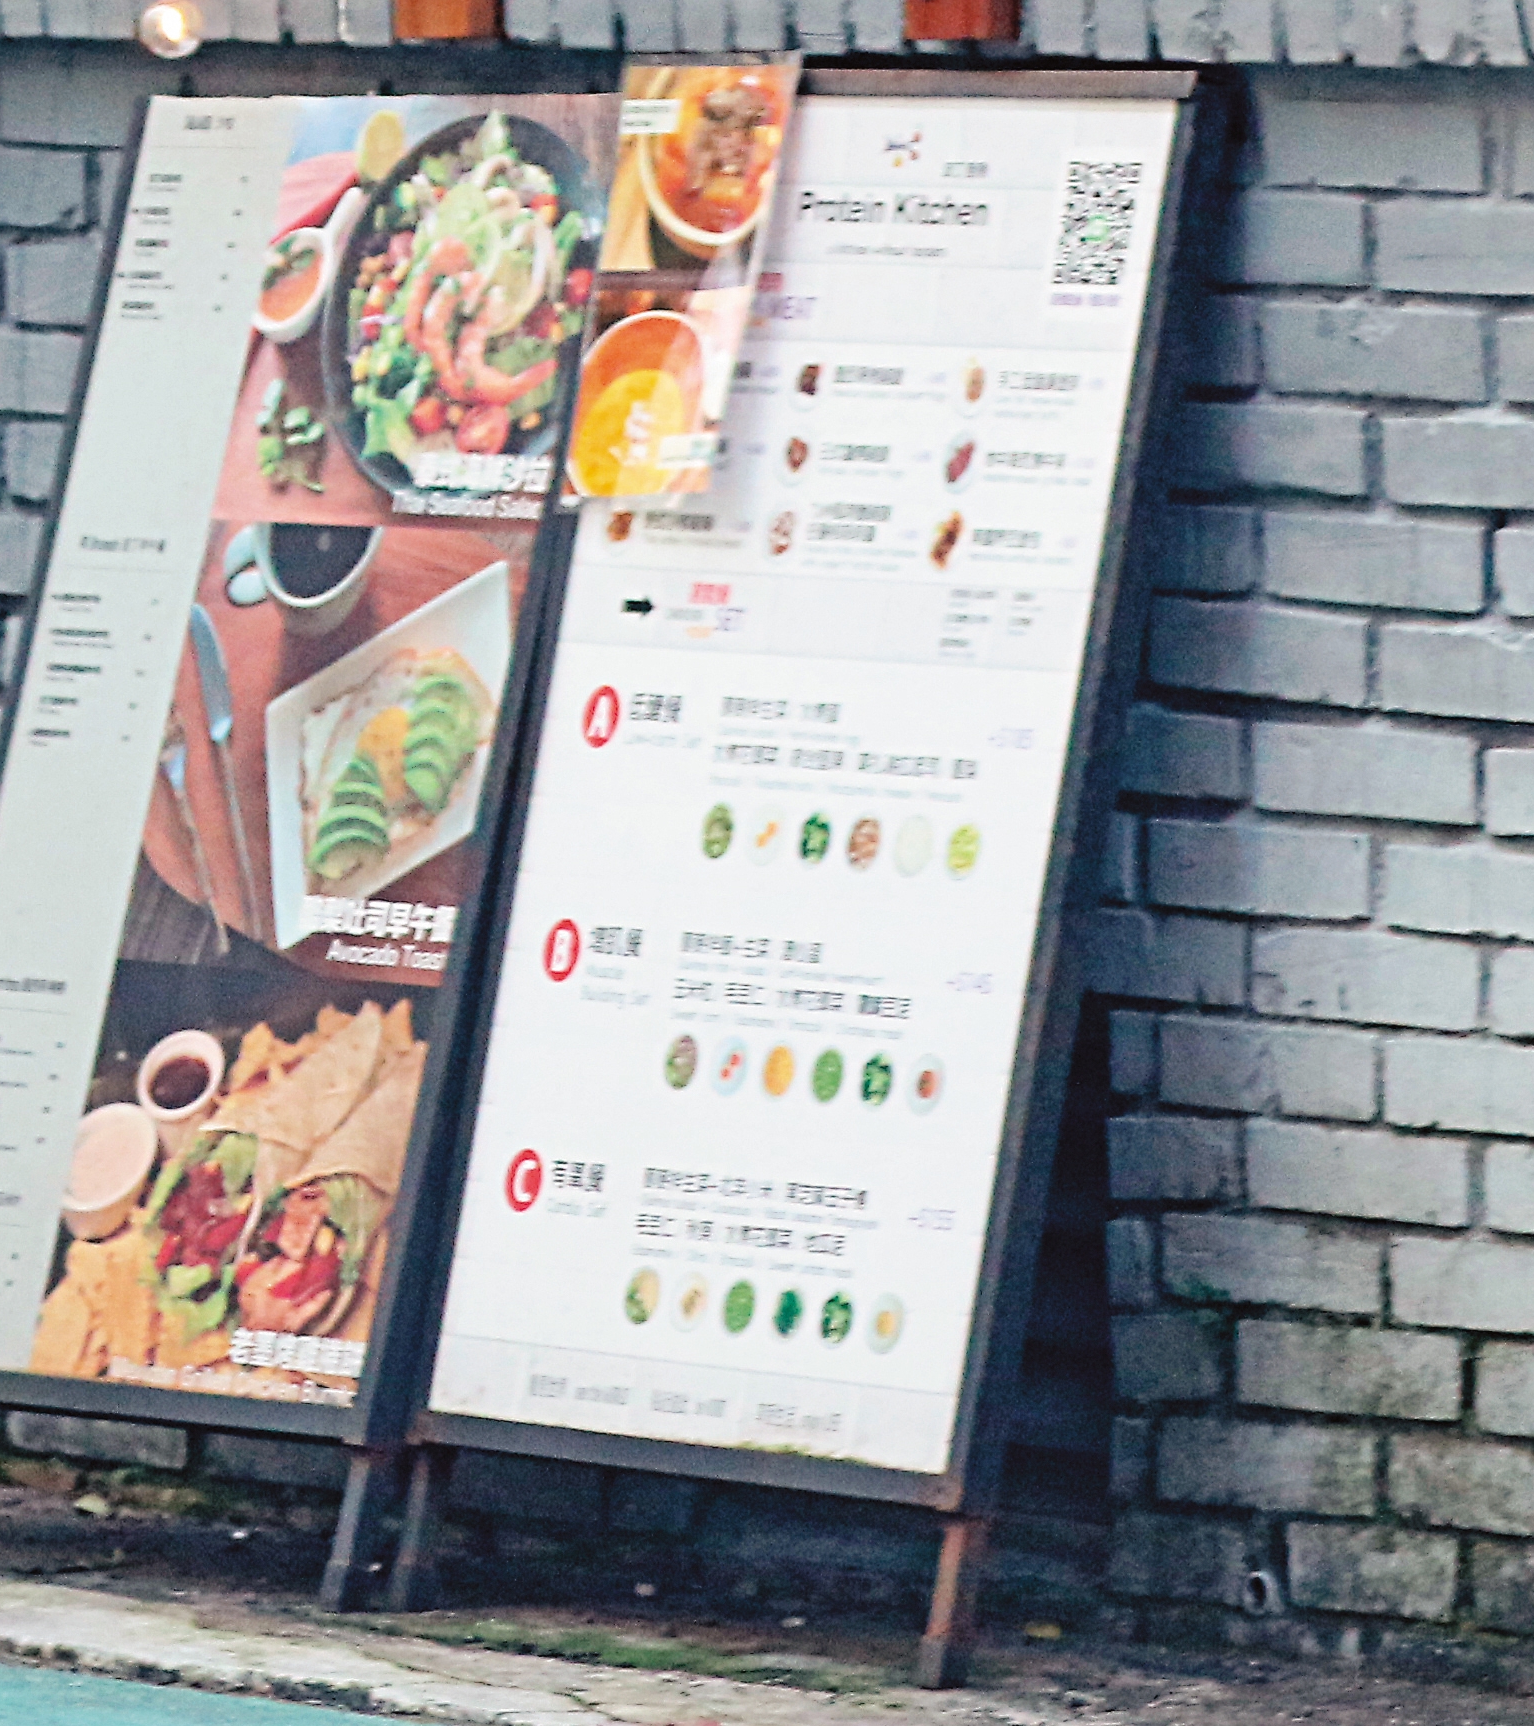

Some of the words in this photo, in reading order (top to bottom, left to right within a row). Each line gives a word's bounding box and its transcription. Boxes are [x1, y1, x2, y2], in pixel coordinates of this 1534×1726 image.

[799, 190, 886, 224] Protein
[891, 192, 988, 226] Kitchen
[325, 938, 400, 967] Avocado
